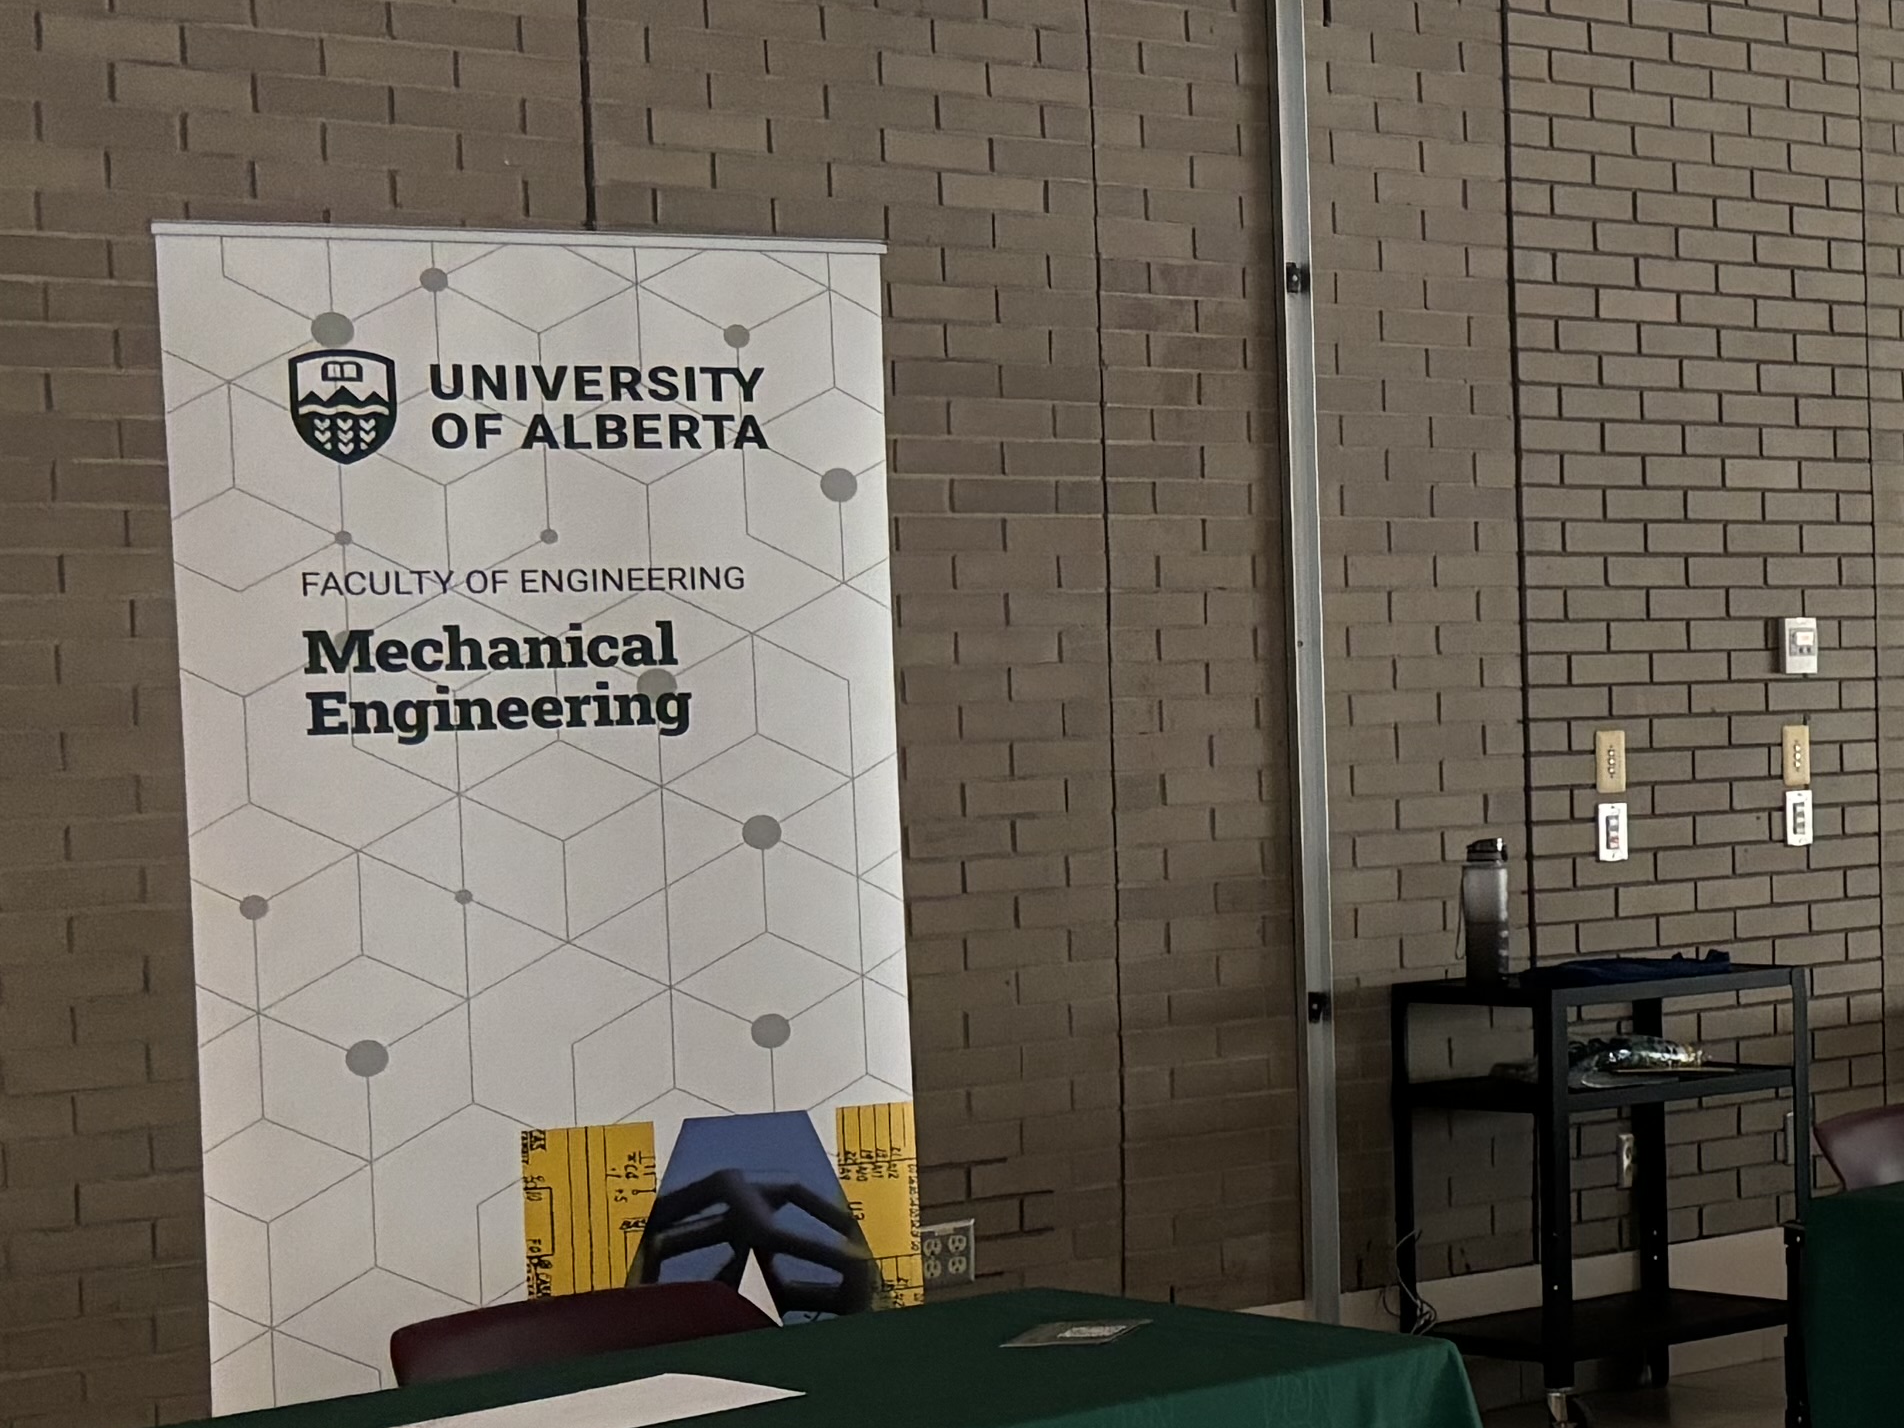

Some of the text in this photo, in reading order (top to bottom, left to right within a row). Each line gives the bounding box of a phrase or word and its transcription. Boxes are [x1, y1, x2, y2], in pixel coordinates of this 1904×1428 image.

[430, 364, 764, 402] UNIVERSITY
[432, 413, 768, 450] OF ALBERTA
[301, 566, 744, 597] FACULTY OF ENGINEERING
[303, 620, 678, 674] Mechanical
[305, 681, 692, 745] Engineering
